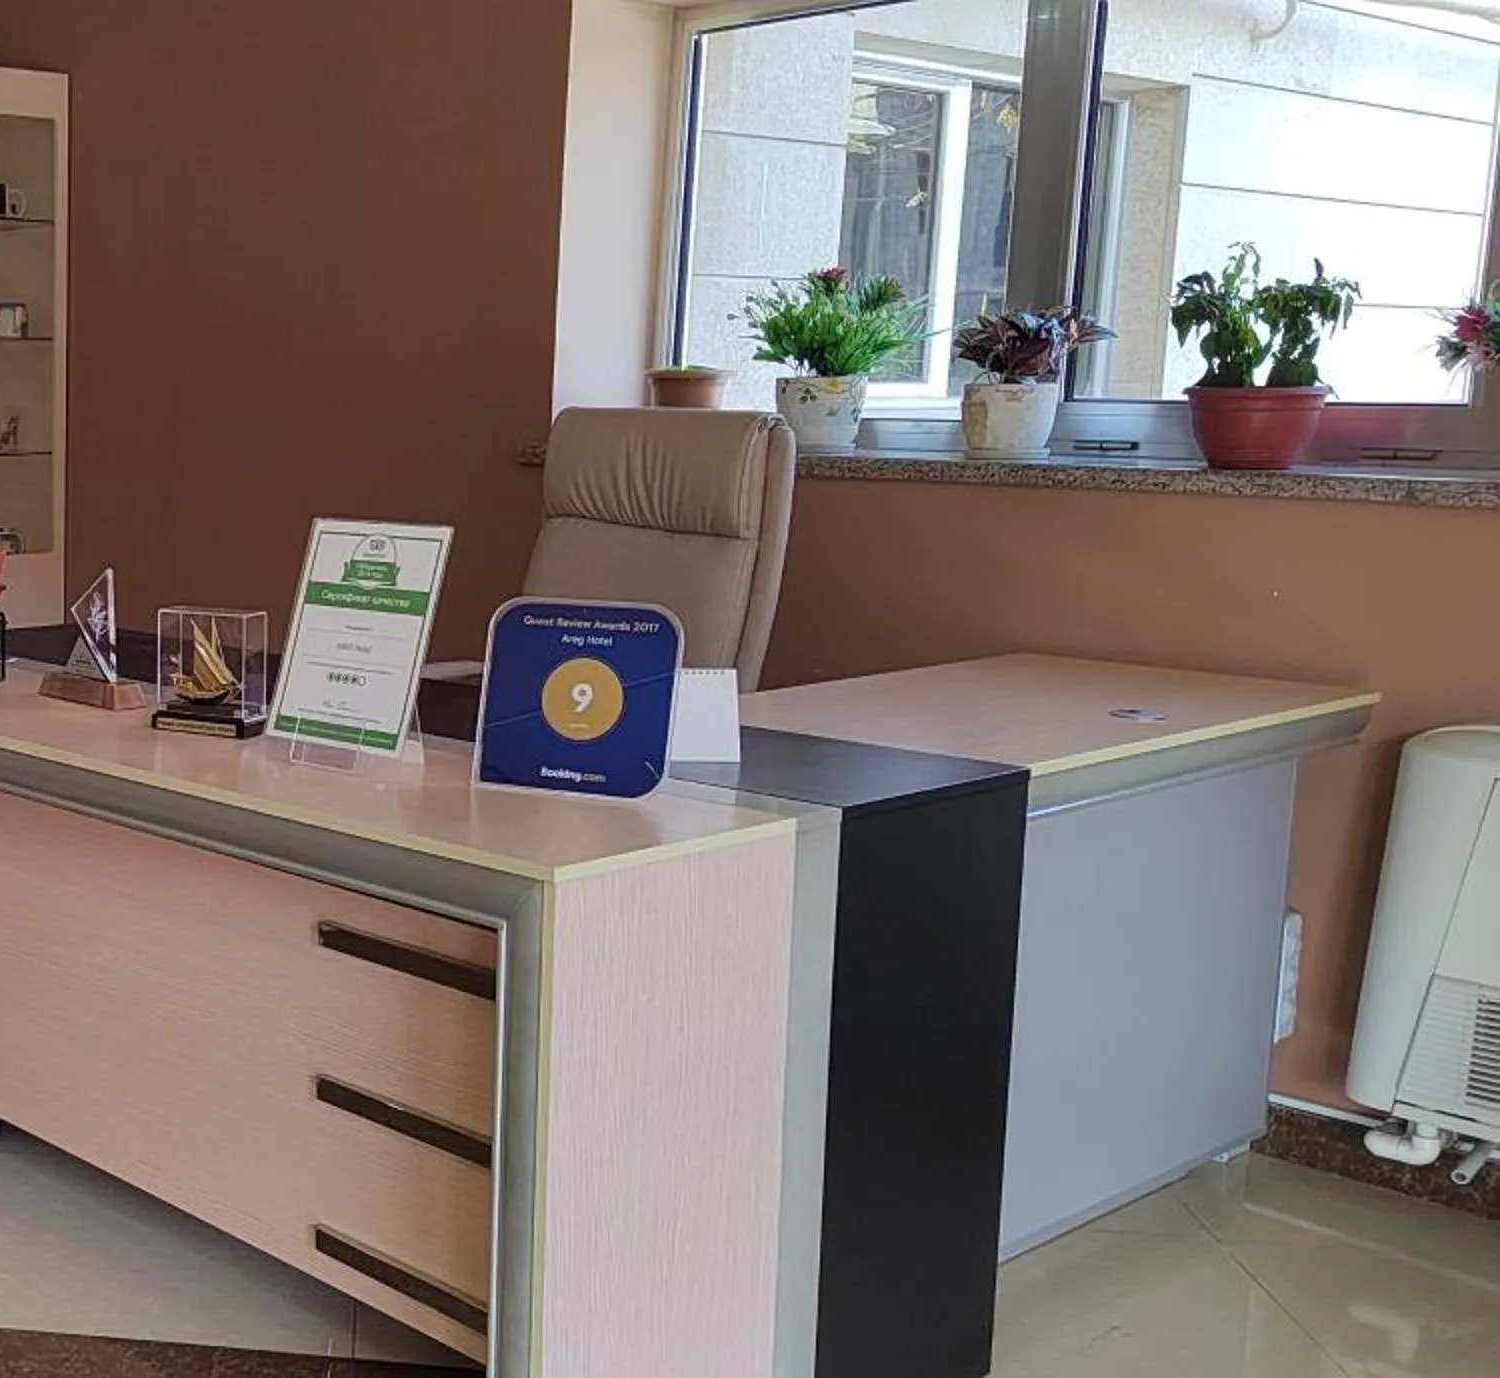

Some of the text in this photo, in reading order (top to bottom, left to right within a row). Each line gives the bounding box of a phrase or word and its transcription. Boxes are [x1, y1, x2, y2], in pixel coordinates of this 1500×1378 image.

[523, 614, 660, 633] Guest Review Awards 2017
[561, 634, 613, 647] Areg Hotel
[572, 683, 593, 713] 9
[541, 767, 606, 783] Booking.com
